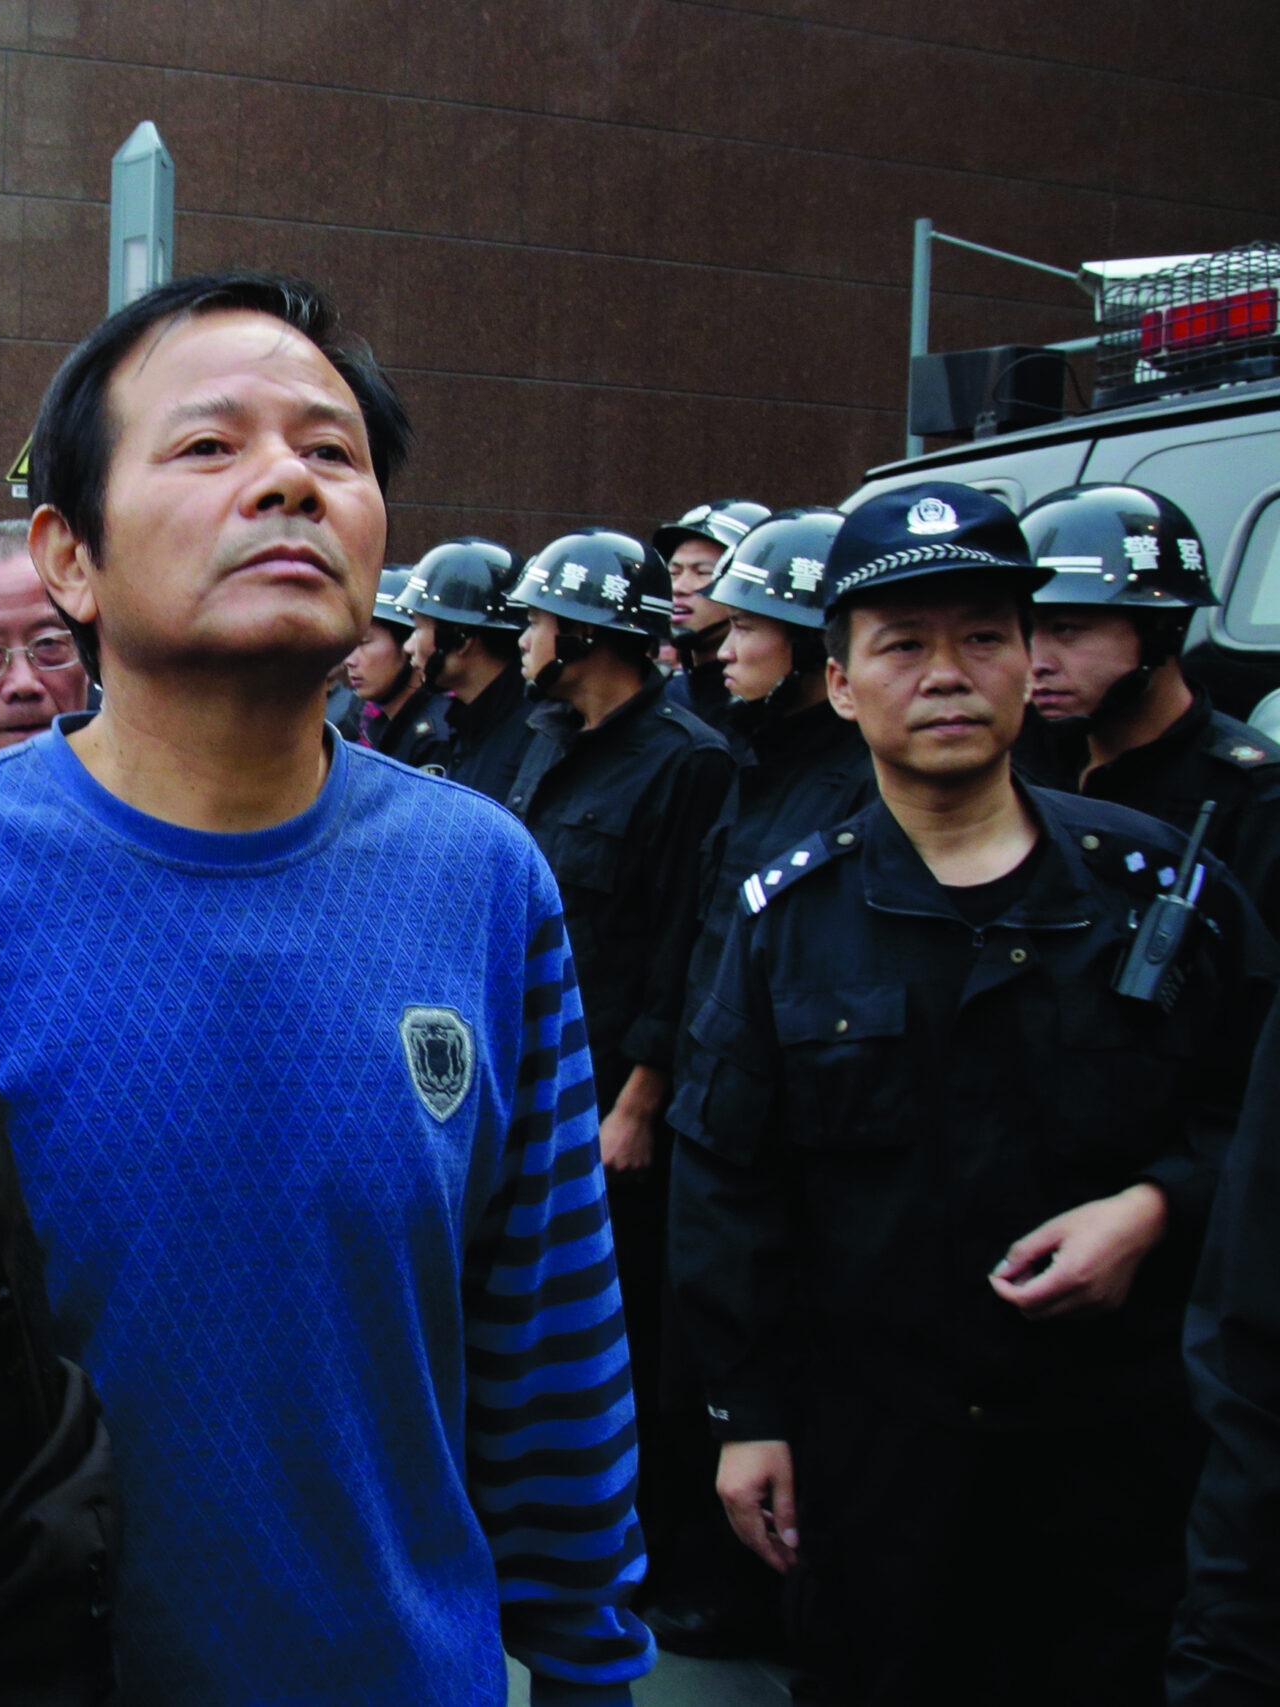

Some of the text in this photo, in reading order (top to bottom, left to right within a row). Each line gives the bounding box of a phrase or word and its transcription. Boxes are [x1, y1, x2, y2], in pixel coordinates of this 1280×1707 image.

[1122, 534, 1203, 571] 警察
[560, 562, 632, 604] 警察
[788, 556, 825, 593] 警
